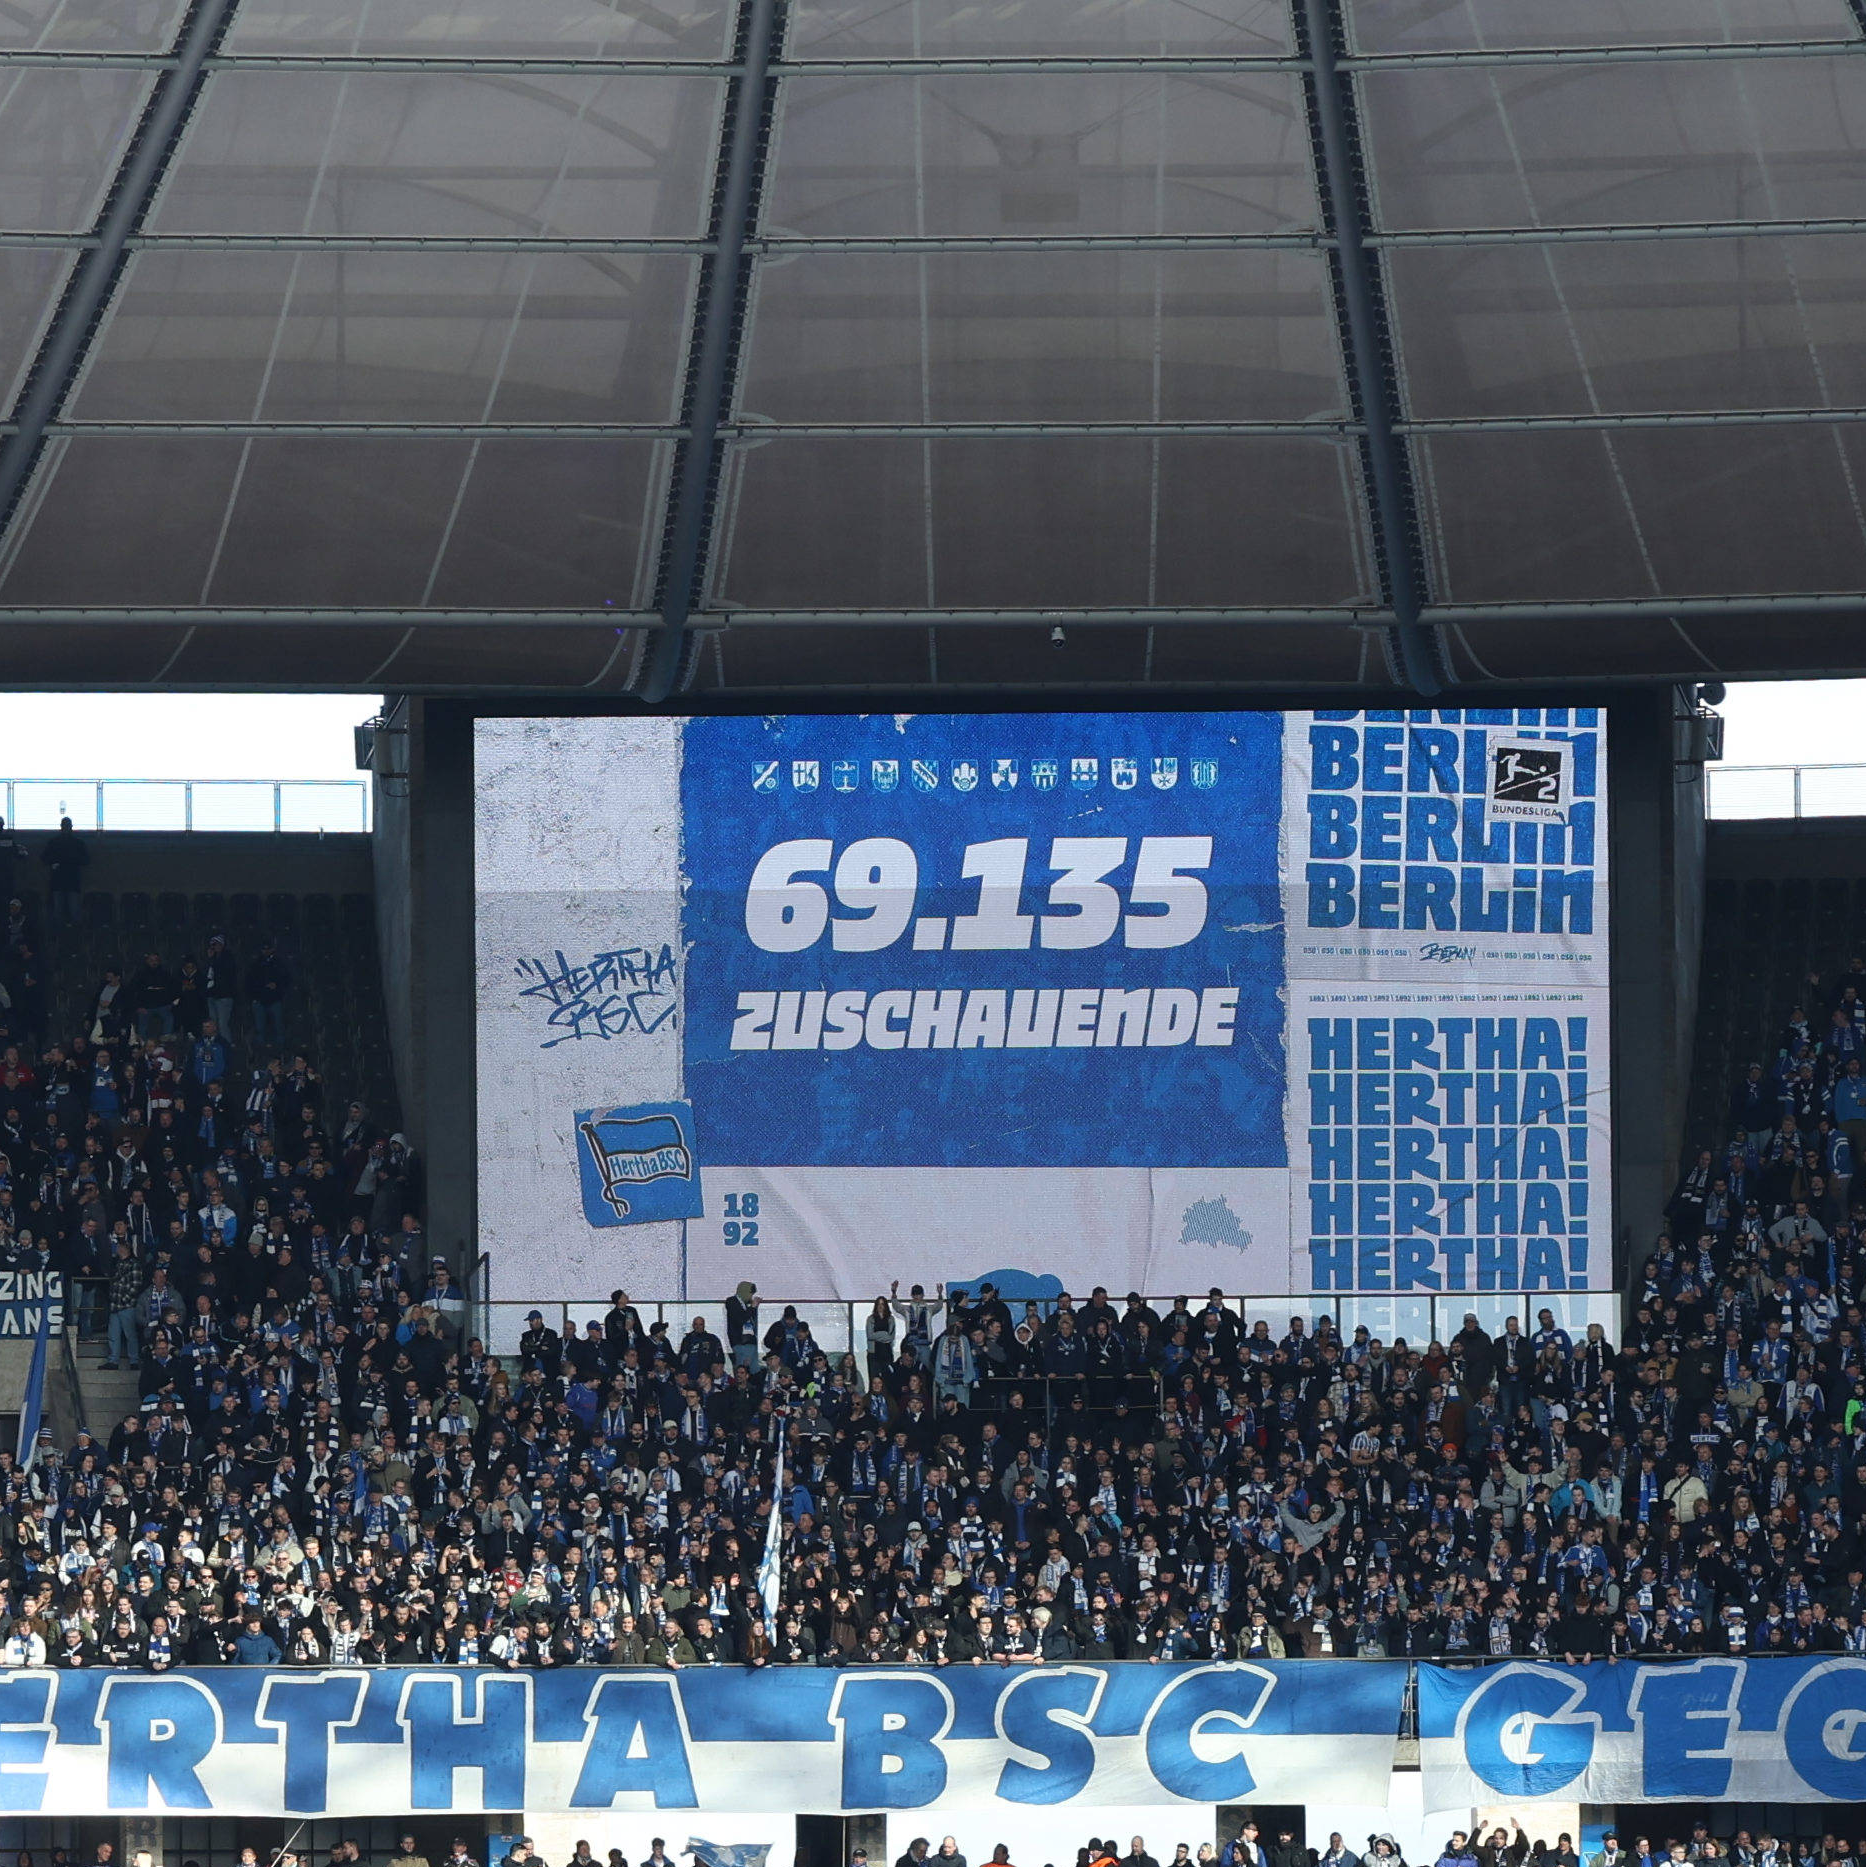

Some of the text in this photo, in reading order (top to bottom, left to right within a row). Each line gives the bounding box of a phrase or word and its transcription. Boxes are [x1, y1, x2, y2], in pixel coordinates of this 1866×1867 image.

[1492, 804, 1559, 818] BUNDESLIGA
[743, 836, 1214, 953] 69.135
[730, 986, 1240, 1051] ZUSCHAUENDE
[1308, 1017, 1588, 1071] HERTHA!
[1308, 1072, 1588, 1126] HERTHA!
[1308, 1126, 1588, 1181] HERTHA!
[723, 1192, 760, 1218] 18
[1308, 1181, 1588, 1236] HERTHA!
[722, 1221, 760, 1246] 92
[1308, 1237, 1588, 1291] HERTHA!
[828, 1661, 1279, 1811] BSC
